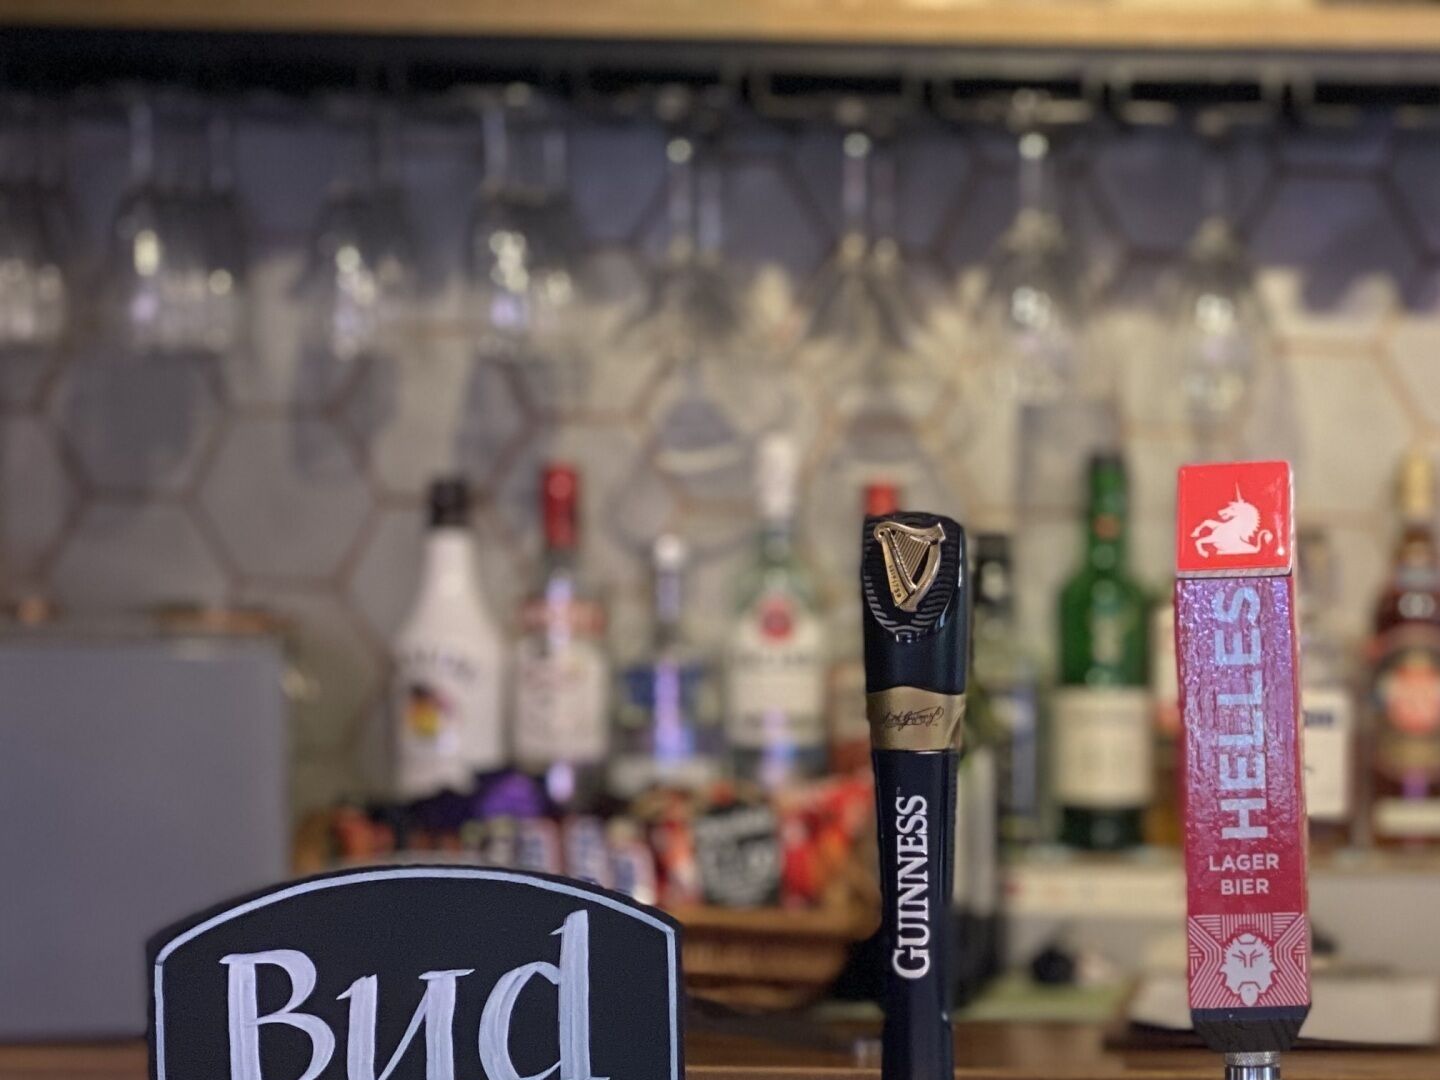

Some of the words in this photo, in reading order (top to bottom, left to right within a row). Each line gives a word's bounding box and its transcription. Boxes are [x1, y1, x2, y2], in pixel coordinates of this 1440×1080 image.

[1210, 586, 1269, 840] HELLES
[891, 793, 932, 980] GUINNESS
[1208, 853, 1280, 873] LAGER
[1220, 877, 1270, 895] BIER
